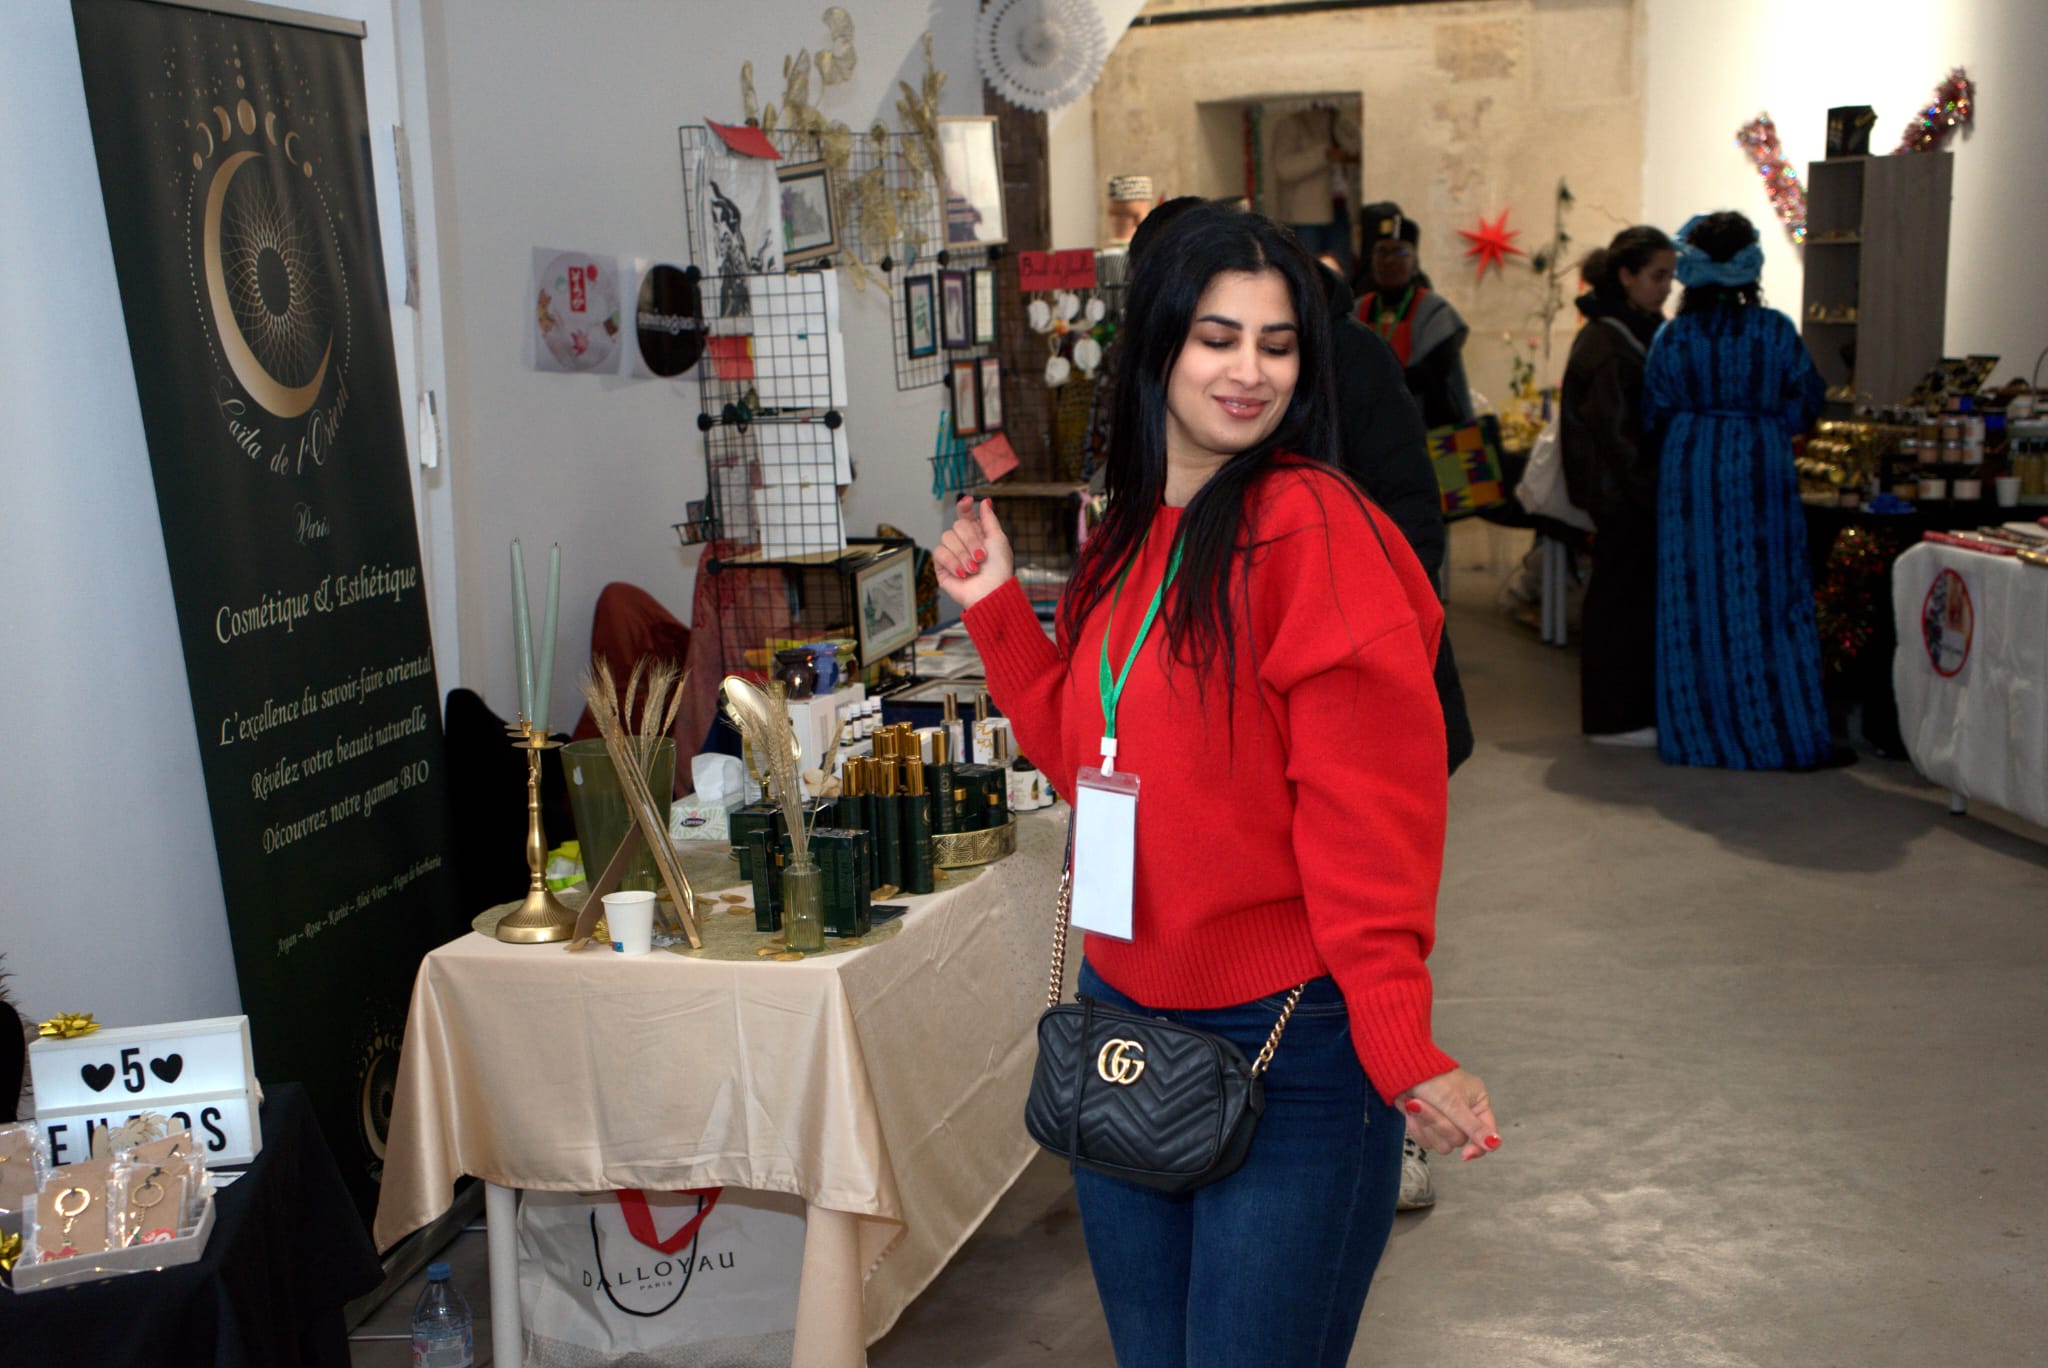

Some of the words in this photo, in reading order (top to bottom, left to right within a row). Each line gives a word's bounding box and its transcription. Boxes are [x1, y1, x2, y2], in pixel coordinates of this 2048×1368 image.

[270, 444, 289, 475] de
[297, 364, 349, 475] l'Orient
[293, 502, 331, 545] Paris
[216, 590, 309, 643] Cosmétique
[314, 575, 334, 612] &
[336, 563, 416, 606] Esthétique
[219, 699, 299, 746] L'excellence
[302, 686, 317, 716] du
[321, 667, 384, 709] savoir-faire
[386, 646, 432, 685] oriental
[251, 757, 300, 800] Révélez
[302, 749, 334, 777] votre
[337, 726, 374, 763] beauté
[376, 705, 427, 747] naturelle
[262, 808, 328, 854] Découvrez
[330, 794, 361, 823] notre
[364, 775, 399, 817] gamme
[400, 759, 430, 791] BIO
[120, 1047, 146, 1093] 5
